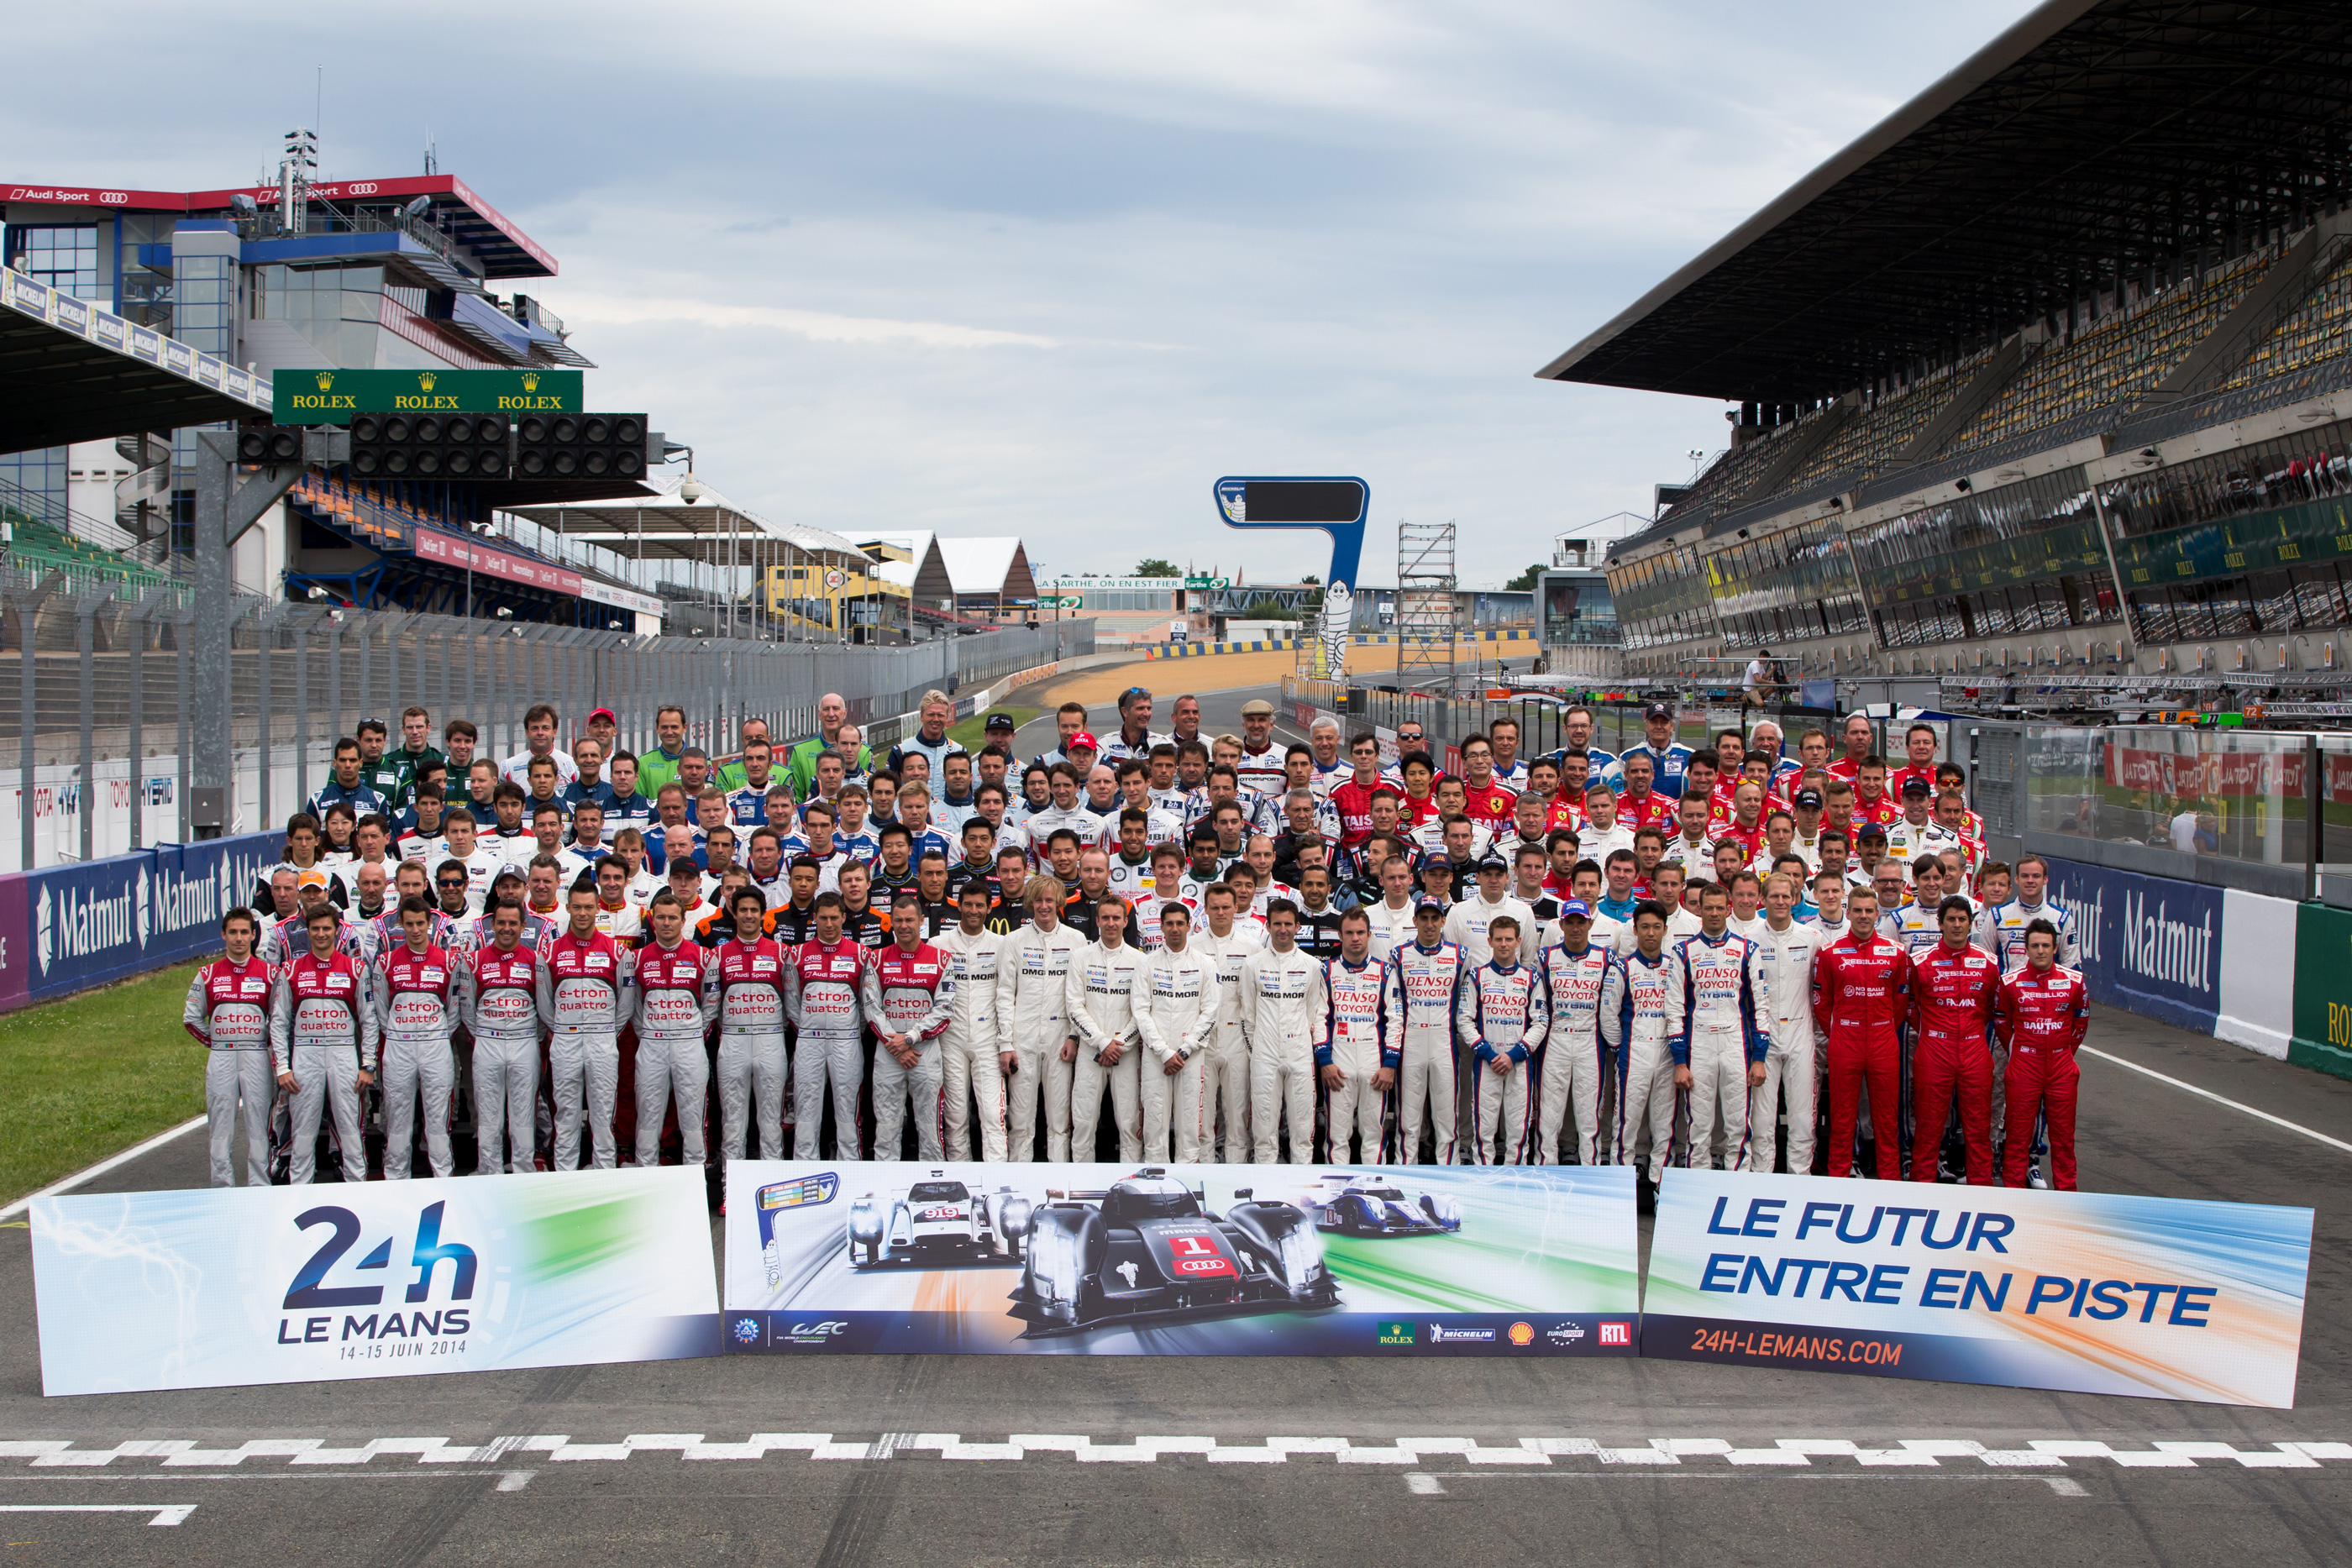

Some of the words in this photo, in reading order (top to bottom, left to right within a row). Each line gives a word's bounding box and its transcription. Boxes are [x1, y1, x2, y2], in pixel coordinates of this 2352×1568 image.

[26, 189, 53, 200] Audi
[55, 191, 90, 202] Sport
[16, 282, 46, 308] MICHELIN
[59, 302, 87, 324] MICHELIN
[98, 317, 123, 340] MICHELIN
[292, 396, 356, 408] ROLEX
[395, 396, 459, 409] ROLEX
[497, 396, 563, 409] ROLEX
[2277, 543, 2301, 560] ROLEX
[2224, 552, 2246, 569] ROLEX
[2176, 560, 2196, 575] ROLEX
[2131, 568, 2150, 582] ROLEX
[1053, 579, 1096, 588] SARTHE,
[1038, 600, 1056, 609] rthe
[2100, 696, 2110, 705] 13
[2165, 712, 2177, 722] 88
[2245, 707, 2257, 716] 72
[2208, 714, 2219, 723] 77
[155, 861, 217, 936] Matmut
[58, 879, 131, 961] Matmut
[2043, 879, 2103, 963] atmut
[2122, 889, 2212, 994] Matmut
[725, 954, 743, 962] ORIS
[804, 954, 822, 962] ORIS
[298, 971, 317, 979] ORIS
[1696, 968, 1739, 978] DENSO
[1406, 976, 1452, 987] DENSO
[1553, 978, 1599, 990] DENSO
[1698, 980, 1735, 989] TOYOTA
[559, 987, 607, 998] e-tron
[1086, 985, 1108, 994] DMG
[1152, 989, 1173, 998] DMG
[1410, 989, 1447, 997] TOYOTA
[1556, 990, 1594, 999] TOYOTA
[1634, 989, 1666, 999] DENS
[483, 997, 529, 1007] e-tron
[727, 992, 774, 1003] e-tron
[806, 992, 851, 1002] e-tron
[885, 997, 931, 1008] e-tron
[1334, 991, 1378, 1004] DENSO
[1482, 994, 1526, 1006] DENSO
[394, 1002, 440, 1012] e-tron
[559, 1000, 607, 1011] quattro
[648, 999, 693, 1009] e-tron
[1335, 1004, 1374, 1013] TOYOTA
[1410, 999, 1447, 1007] HYBRID
[1557, 1001, 1594, 1009] HYBRID
[300, 1008, 348, 1019] e-tron
[484, 1009, 528, 1019] quattro
[728, 1005, 775, 1015] quattro
[805, 1004, 850, 1015] quattro
[1485, 1007, 1522, 1016] TOYOTA
[214, 1013, 261, 1023] e-tron
[395, 1015, 438, 1025] quattro
[647, 1011, 692, 1021] quattro
[1336, 1015, 1375, 1023] HYBRID
[1486, 1017, 1523, 1025] HYBRID
[215, 1025, 260, 1036] quattro
[300, 1020, 347, 1031] quattro
[924, 1208, 958, 1219] 919
[1328, 1210, 1333, 1223] 8
[1795, 1202, 2016, 1254] FUTUR
[1179, 1237, 1211, 1255] 1
[282, 1199, 478, 1309] 24h
[1699, 1254, 1910, 1305] ENTRE
[1919, 1268, 2013, 1312] EN
[2024, 1275, 2218, 1328] PISTE
[341, 1308, 470, 1342] MANS
[790, 1321, 848, 1335] WEC
[1443, 1329, 1494, 1338] MICHELIN
[1601, 1324, 1628, 1343] RTL
[1380, 1335, 1413, 1344] ROLEX
[339, 1345, 384, 1361] 14-15
[389, 1343, 424, 1358] JUIN
[429, 1340, 467, 1356] 2014
[1691, 1328, 1903, 1366] 24H-LEMANS.COM
